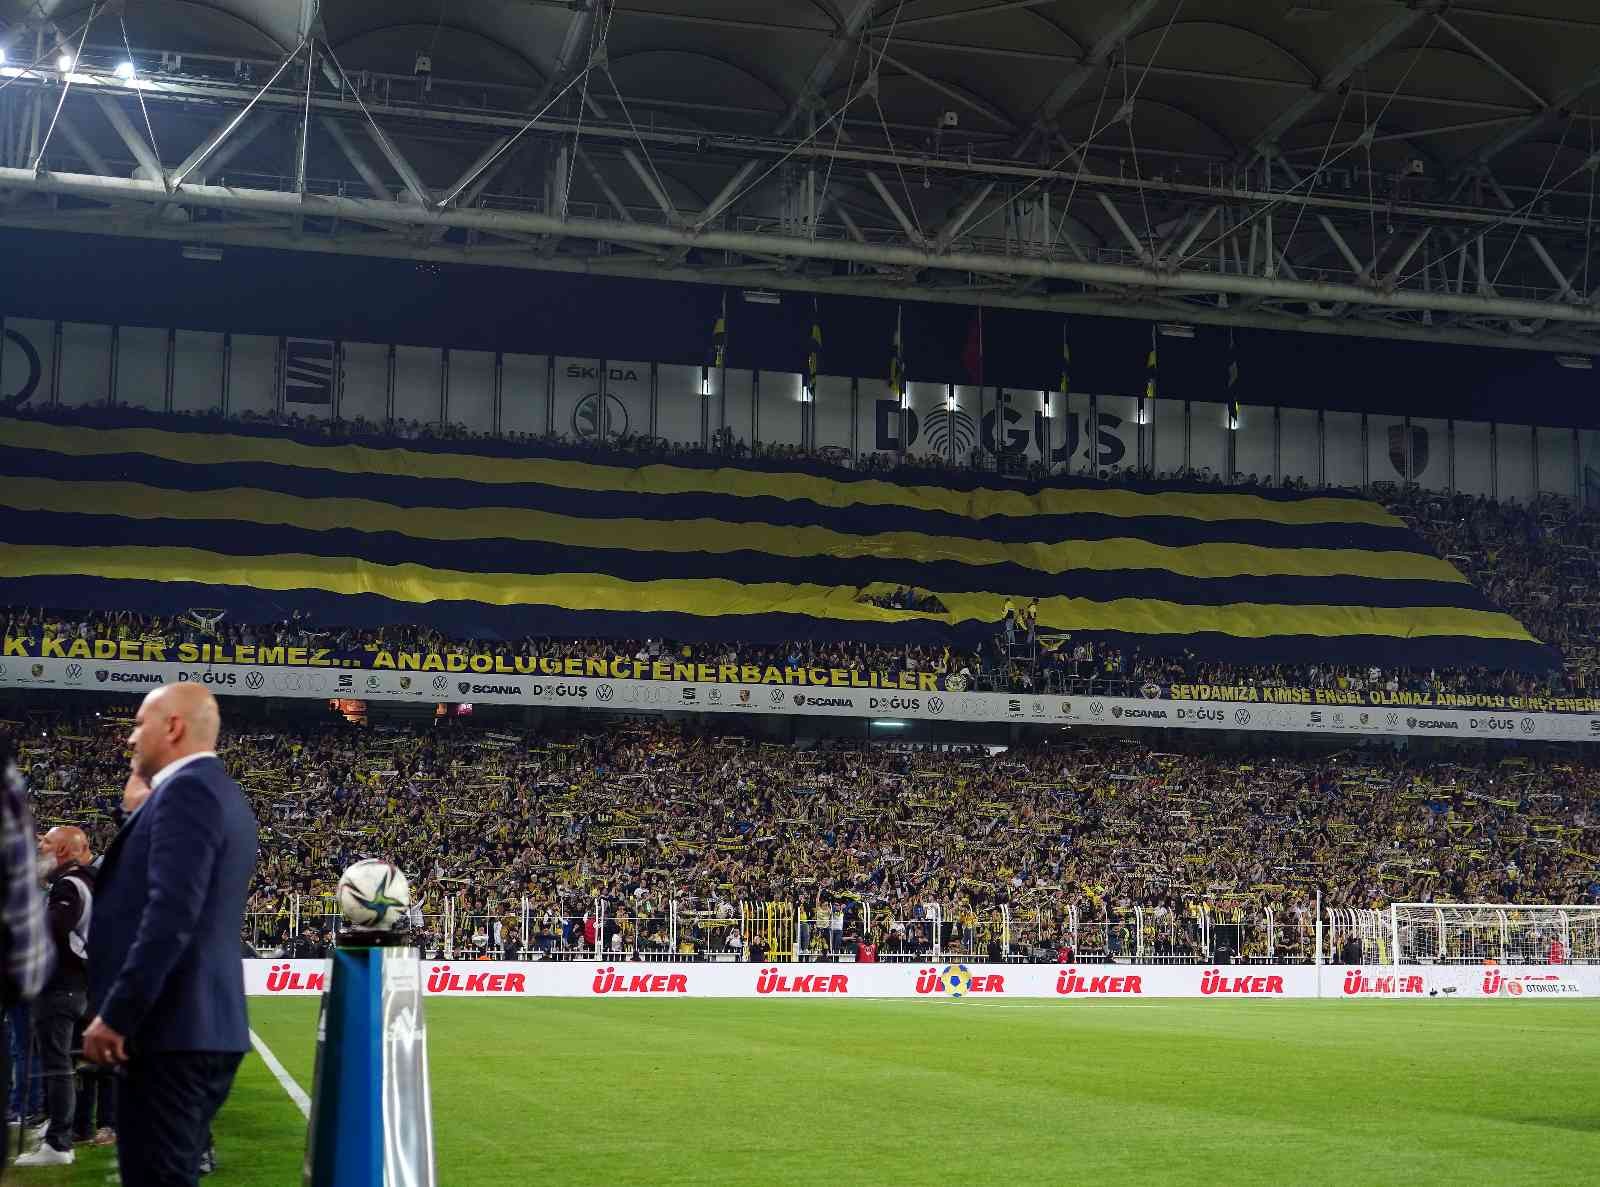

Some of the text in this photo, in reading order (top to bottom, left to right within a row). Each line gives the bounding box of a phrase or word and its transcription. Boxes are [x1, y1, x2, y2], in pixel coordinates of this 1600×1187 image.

[41, 638, 166, 661] KADER
[110, 671, 164, 684] SCANIA
[472, 684, 522, 695] SCANIA
[806, 697, 854, 708] SCANIA
[1171, 684, 1258, 701] SEVDAMIZA
[1370, 690, 1432, 705] OLAMAZ
[1124, 709, 1168, 719] SCANIA
[1418, 720, 1458, 730] SCANIA
[266, 964, 325, 991] ÜLK
[427, 966, 525, 993] ÜLKER
[592, 967, 687, 994] ÜLKER
[757, 968, 848, 994] ÜLKER
[916, 968, 1004, 993] ÜLER
[1056, 969, 1141, 995] ÜLKER
[1201, 971, 1283, 995] ÜLKER
[1344, 970, 1423, 995] ÜLKER
